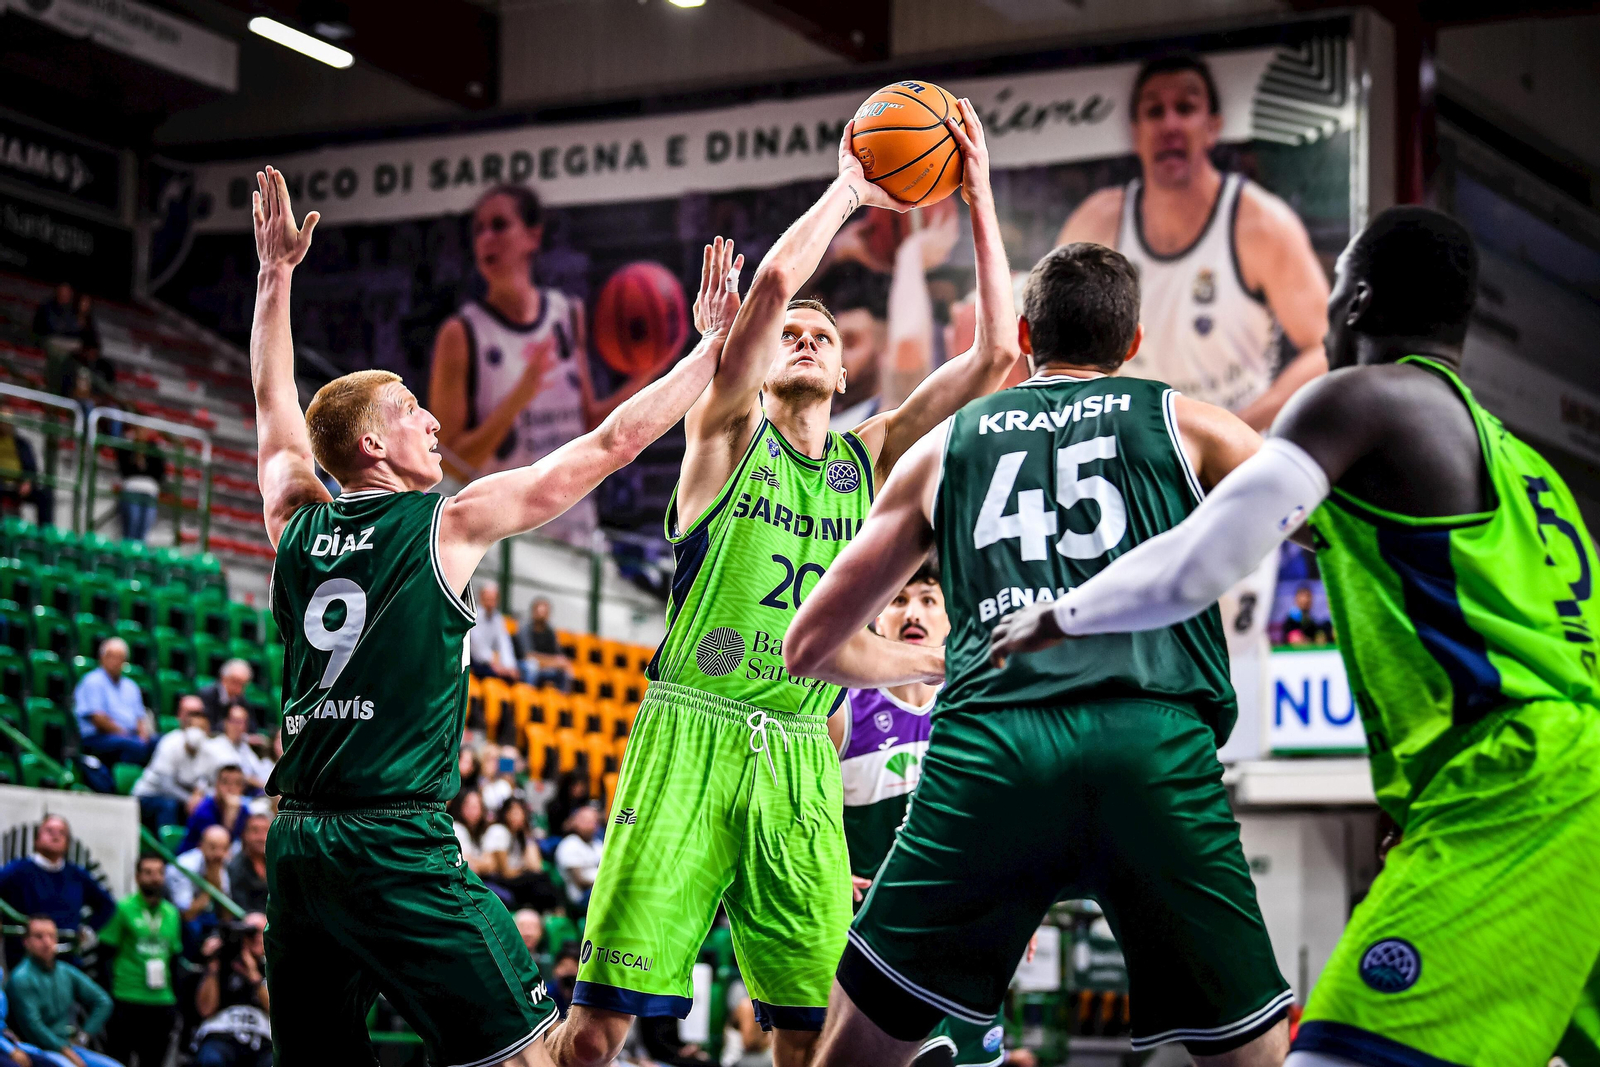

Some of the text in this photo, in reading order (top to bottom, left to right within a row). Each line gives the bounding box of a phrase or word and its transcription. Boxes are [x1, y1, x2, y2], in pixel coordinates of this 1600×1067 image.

[374, 162, 413, 194] DI
[428, 140, 648, 190] SARDEGNA
[665, 134, 690, 168] E
[978, 393, 1132, 435] KRAVISH
[973, 434, 1127, 562] 45
[310, 526, 375, 557] DÍAZ
[303, 577, 367, 689] 9
[596, 946, 654, 972] TISCALI
